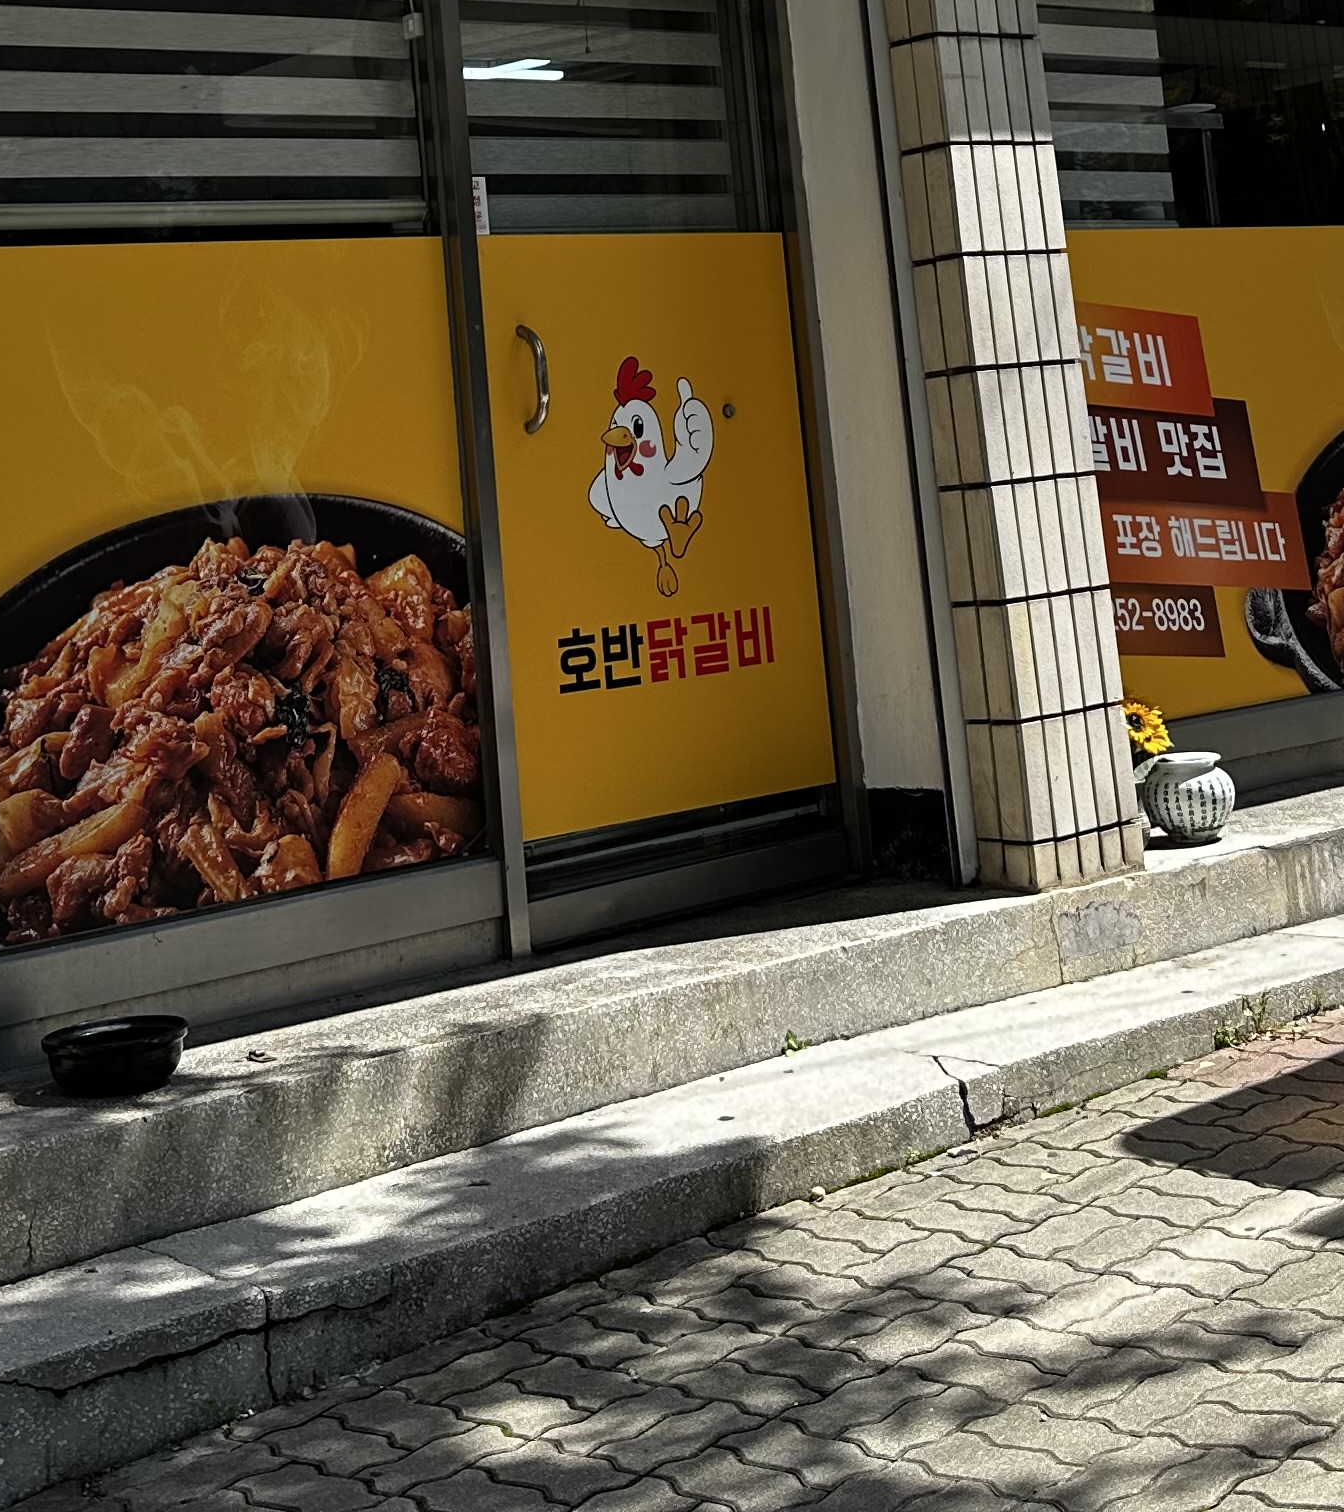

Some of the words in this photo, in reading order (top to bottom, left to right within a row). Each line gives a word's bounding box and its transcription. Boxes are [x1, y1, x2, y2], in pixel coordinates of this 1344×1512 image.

[1157, 421, 1227, 479] 맛집
[1112, 514, 1162, 557] 포장
[1168, 515, 1286, 561] 해드립니다
[1114, 598, 1205, 631] 52-8983
[557, 606, 775, 694] 호반닭갈비
